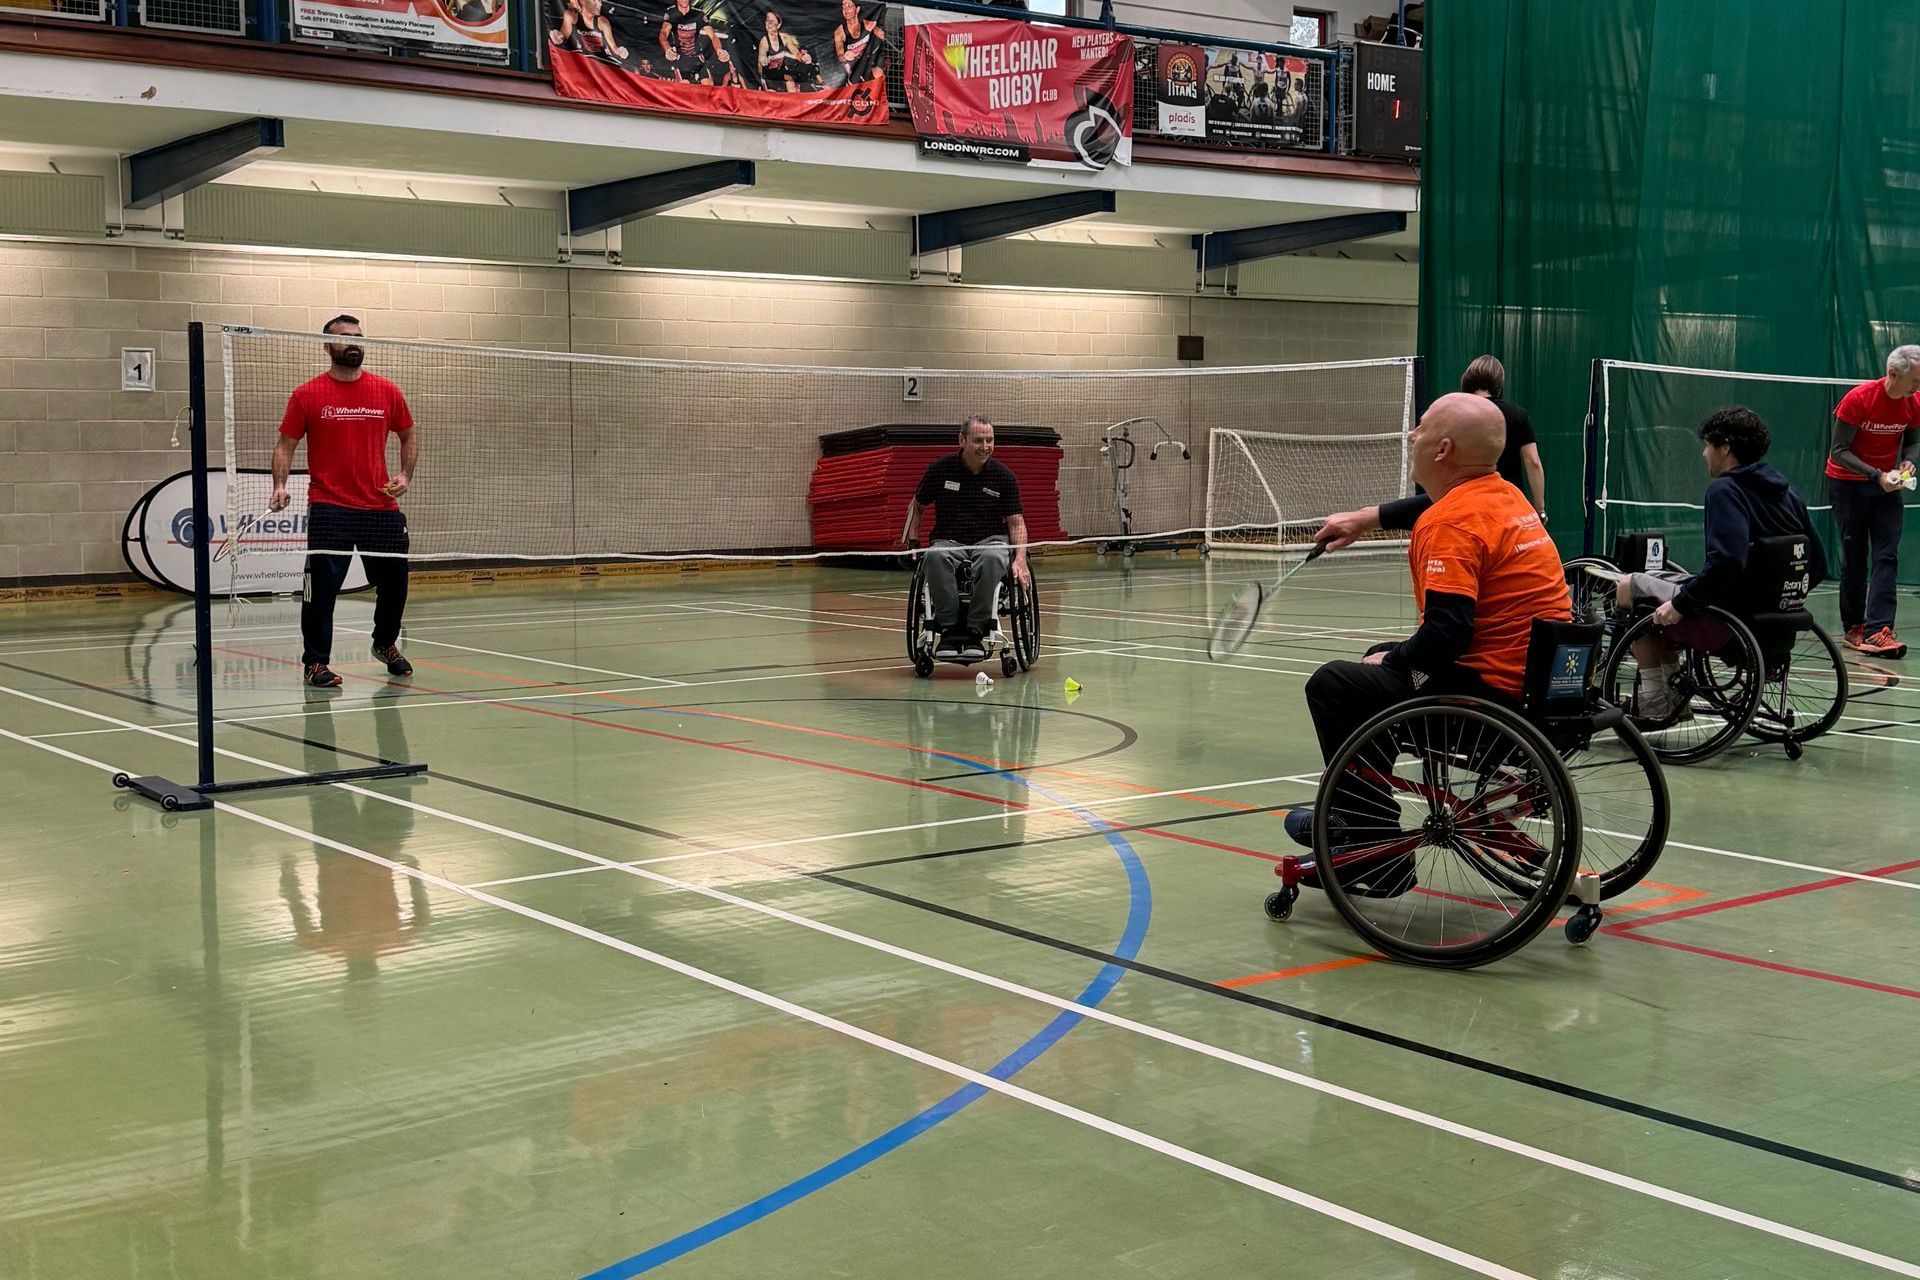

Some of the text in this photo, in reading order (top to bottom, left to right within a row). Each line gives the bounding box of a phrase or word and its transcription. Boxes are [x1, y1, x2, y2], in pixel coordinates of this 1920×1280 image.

[317, 10, 338, 18] Training
[345, 14, 379, 22] Qualification
[946, 32, 973, 46] LONDON
[1072, 32, 1114, 48] NEW PLAYERS
[955, 38, 1058, 80] WHEELCHAIR
[1080, 46, 1109, 61] WANTED!
[1167, 78, 1198, 99] TITANS
[1367, 72, 1396, 92] HOME
[989, 72, 1058, 110] RUGBY CLUB
[1168, 112, 1196, 125] pladis
[924, 141, 1020, 158] LONDONWRC.COM
[133, 362, 143, 381] 1
[907, 377, 918, 396] 2
[335, 406, 385, 415] WheelPower
[1783, 580, 1802, 591] Rotary
